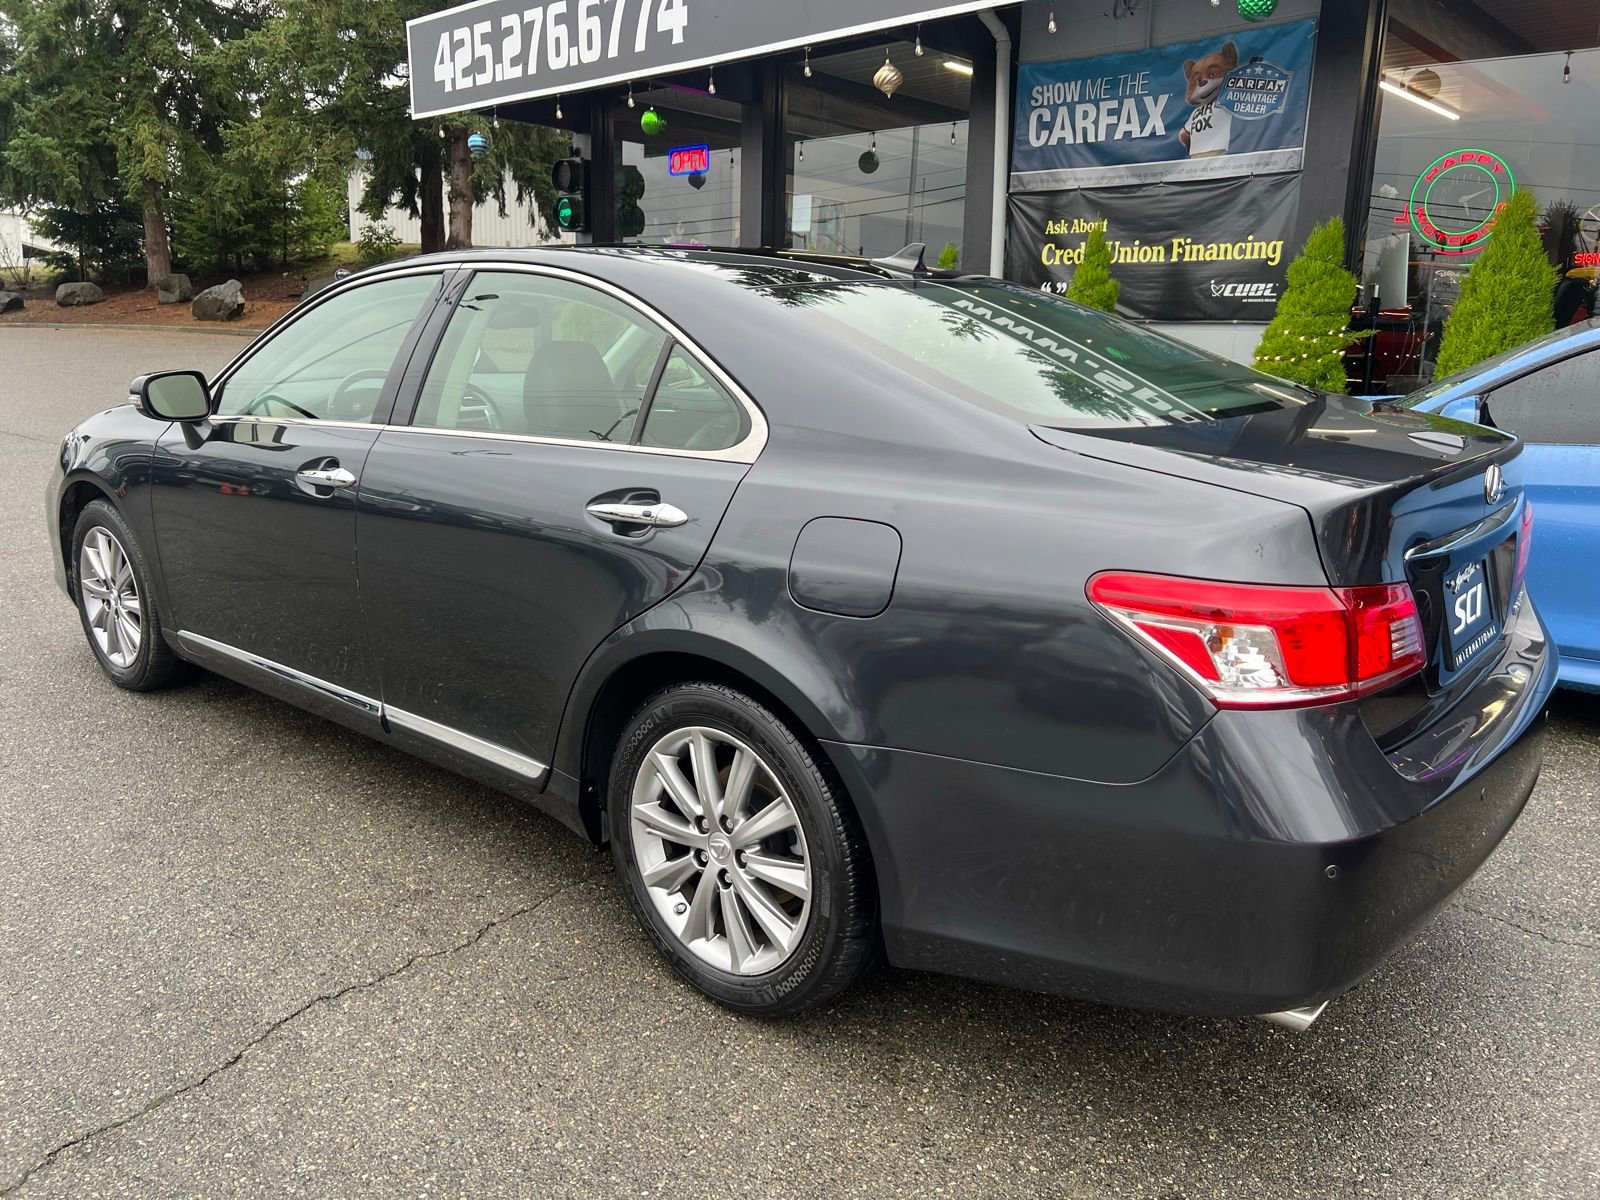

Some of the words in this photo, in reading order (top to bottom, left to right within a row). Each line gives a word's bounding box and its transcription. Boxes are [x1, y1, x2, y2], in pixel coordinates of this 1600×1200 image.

[434, 0, 687, 92] 425.276.6774
[1030, 80, 1081, 107] SHOW
[1086, 77, 1113, 100] ME
[1117, 71, 1150, 97] THE
[1227, 92, 1278, 104] ADVANTAGE
[1228, 78, 1284, 92] CARFAX
[1028, 94, 1169, 147] CARFAX
[1192, 102, 1214, 121] CAR
[1233, 103, 1267, 114] DEALER
[671, 149, 707, 173] OPEN
[1425, 153, 1505, 182] HAPPY
[1045, 220, 1069, 235] Ask
[1071, 218, 1108, 234] About
[1041, 243, 1086, 266] Cred
[1170, 235, 1284, 266] Financing
[1453, 582, 1482, 635] SCI
[1455, 625, 1497, 667] INTERNATIONAL
